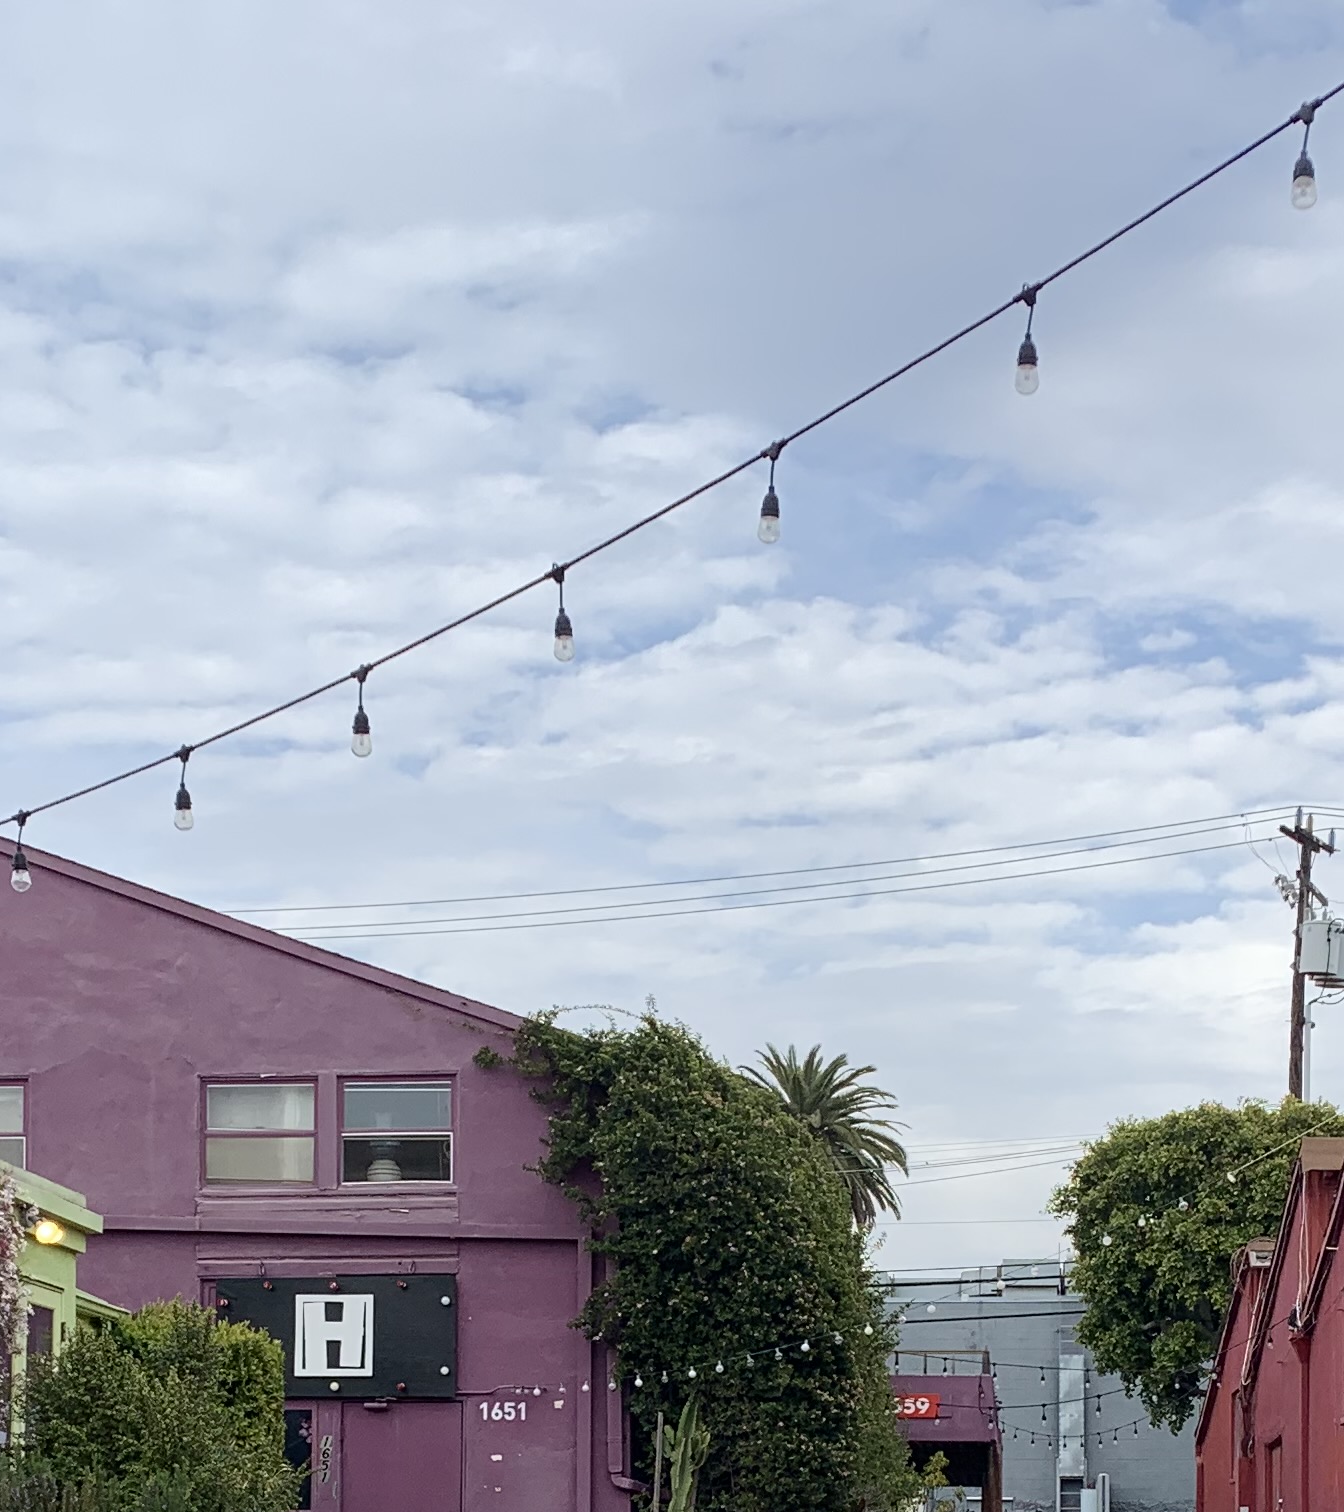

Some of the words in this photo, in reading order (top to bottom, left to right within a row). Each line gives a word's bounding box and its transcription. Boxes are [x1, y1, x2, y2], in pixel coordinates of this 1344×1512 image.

[299, 1299, 369, 1372] H
[479, 1402, 526, 1421] 1651
[321, 1436, 331, 1483] 1651
